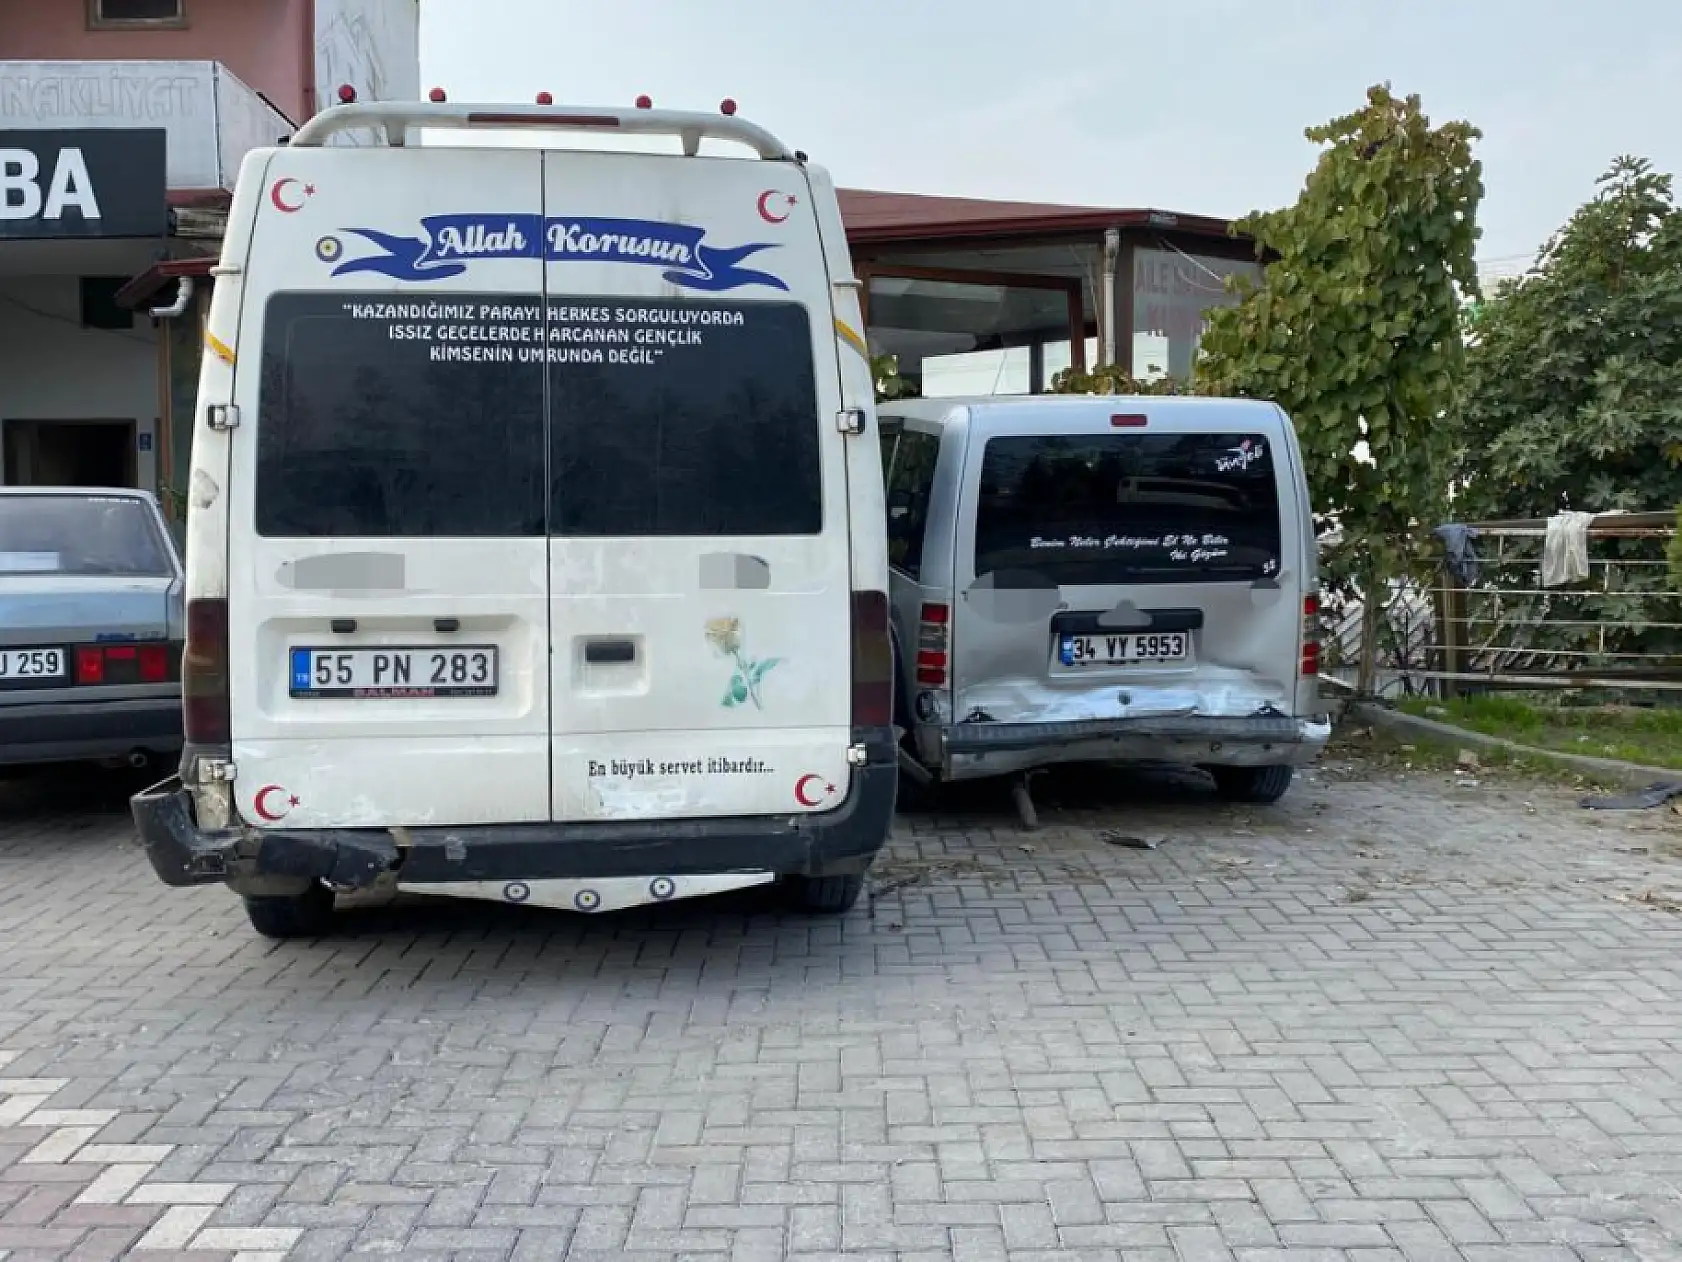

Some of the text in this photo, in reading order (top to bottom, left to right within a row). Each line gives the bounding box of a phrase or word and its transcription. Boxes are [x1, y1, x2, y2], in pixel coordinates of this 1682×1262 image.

[0, 148, 101, 219] BA
[437, 222, 693, 263] Allah Korusun
[479, 304, 541, 321] PARAYI
[547, 306, 610, 323] HERKES
[614, 308, 745, 326] SORGULUYORDA
[437, 325, 532, 342] GECELERDE
[634, 327, 702, 348] GENÇLİK
[430, 342, 513, 362] KİMSENİN
[518, 347, 603, 364] UMRUNDA
[1073, 635, 1183, 660] 34 VY 5953
[17, 651, 59, 674] 259
[316, 654, 354, 685] 55
[373, 654, 411, 685] PN
[430, 652, 489, 684] 283
[588, 760, 606, 777] En
[610, 759, 654, 780] büyük
[660, 758, 703, 776] servet
